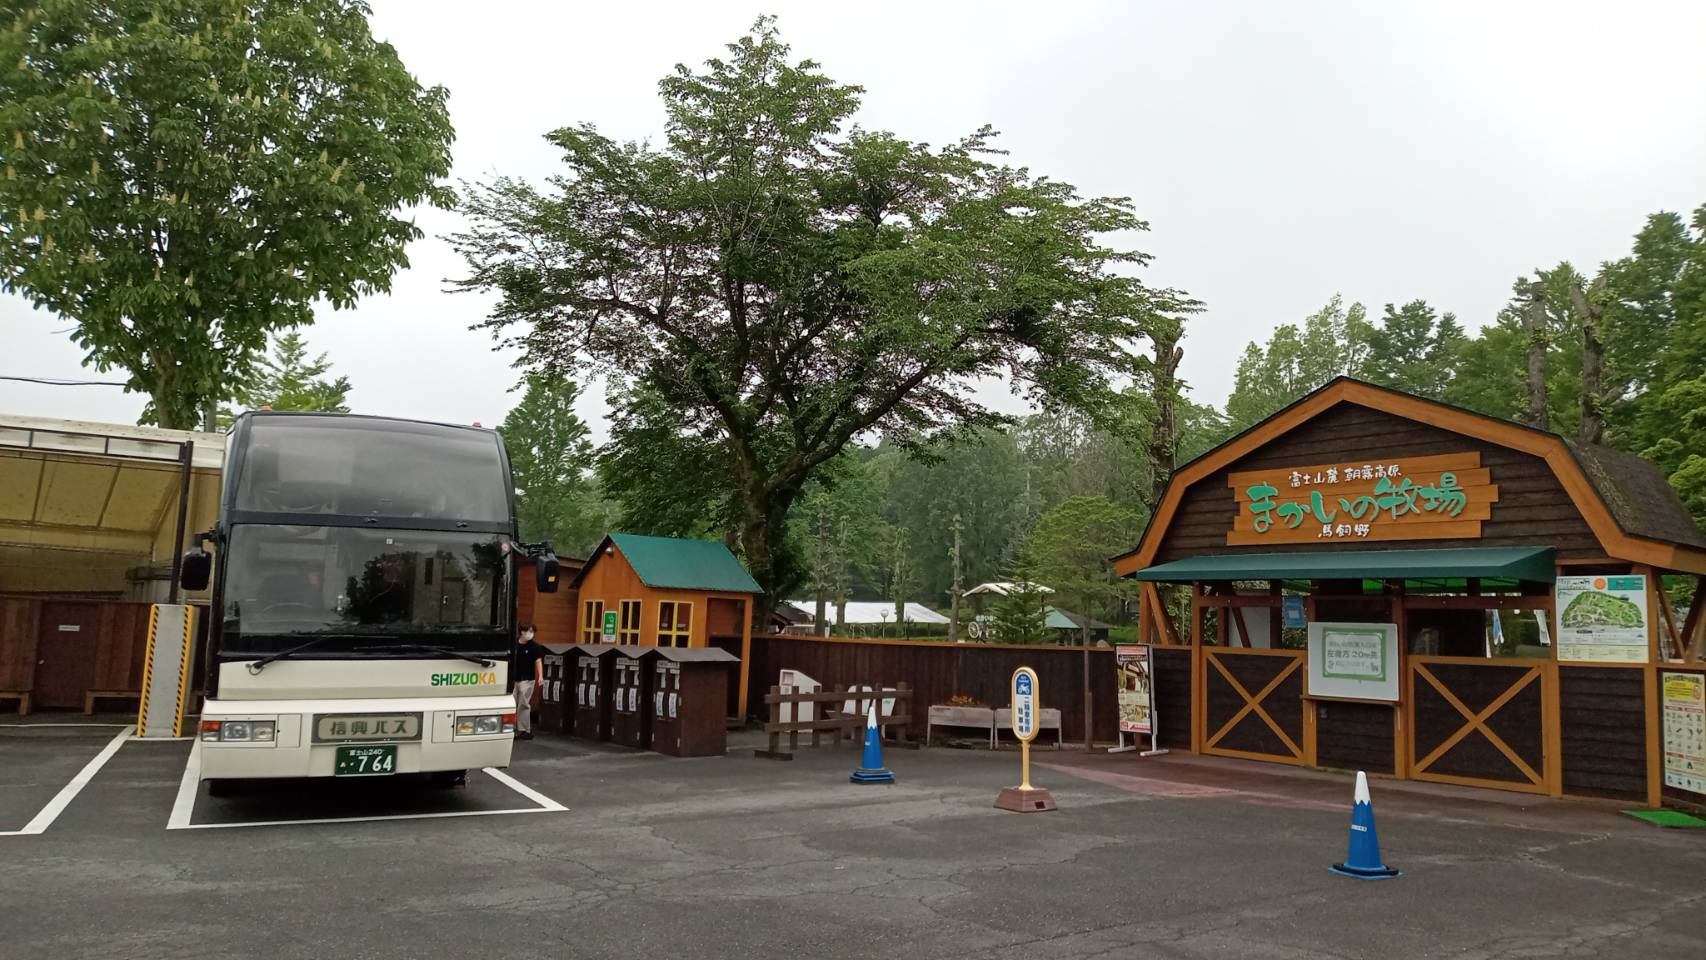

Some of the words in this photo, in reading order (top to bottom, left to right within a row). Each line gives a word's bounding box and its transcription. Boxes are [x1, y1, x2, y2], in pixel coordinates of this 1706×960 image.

[1288, 467, 1340, 488] 富士山麓
[1343, 463, 1402, 483] 朝霧高原
[1246, 470, 1467, 534] まかいの牧場
[431, 672, 497, 687] SHIZUOKA
[329, 719, 408, 736] 信興バス
